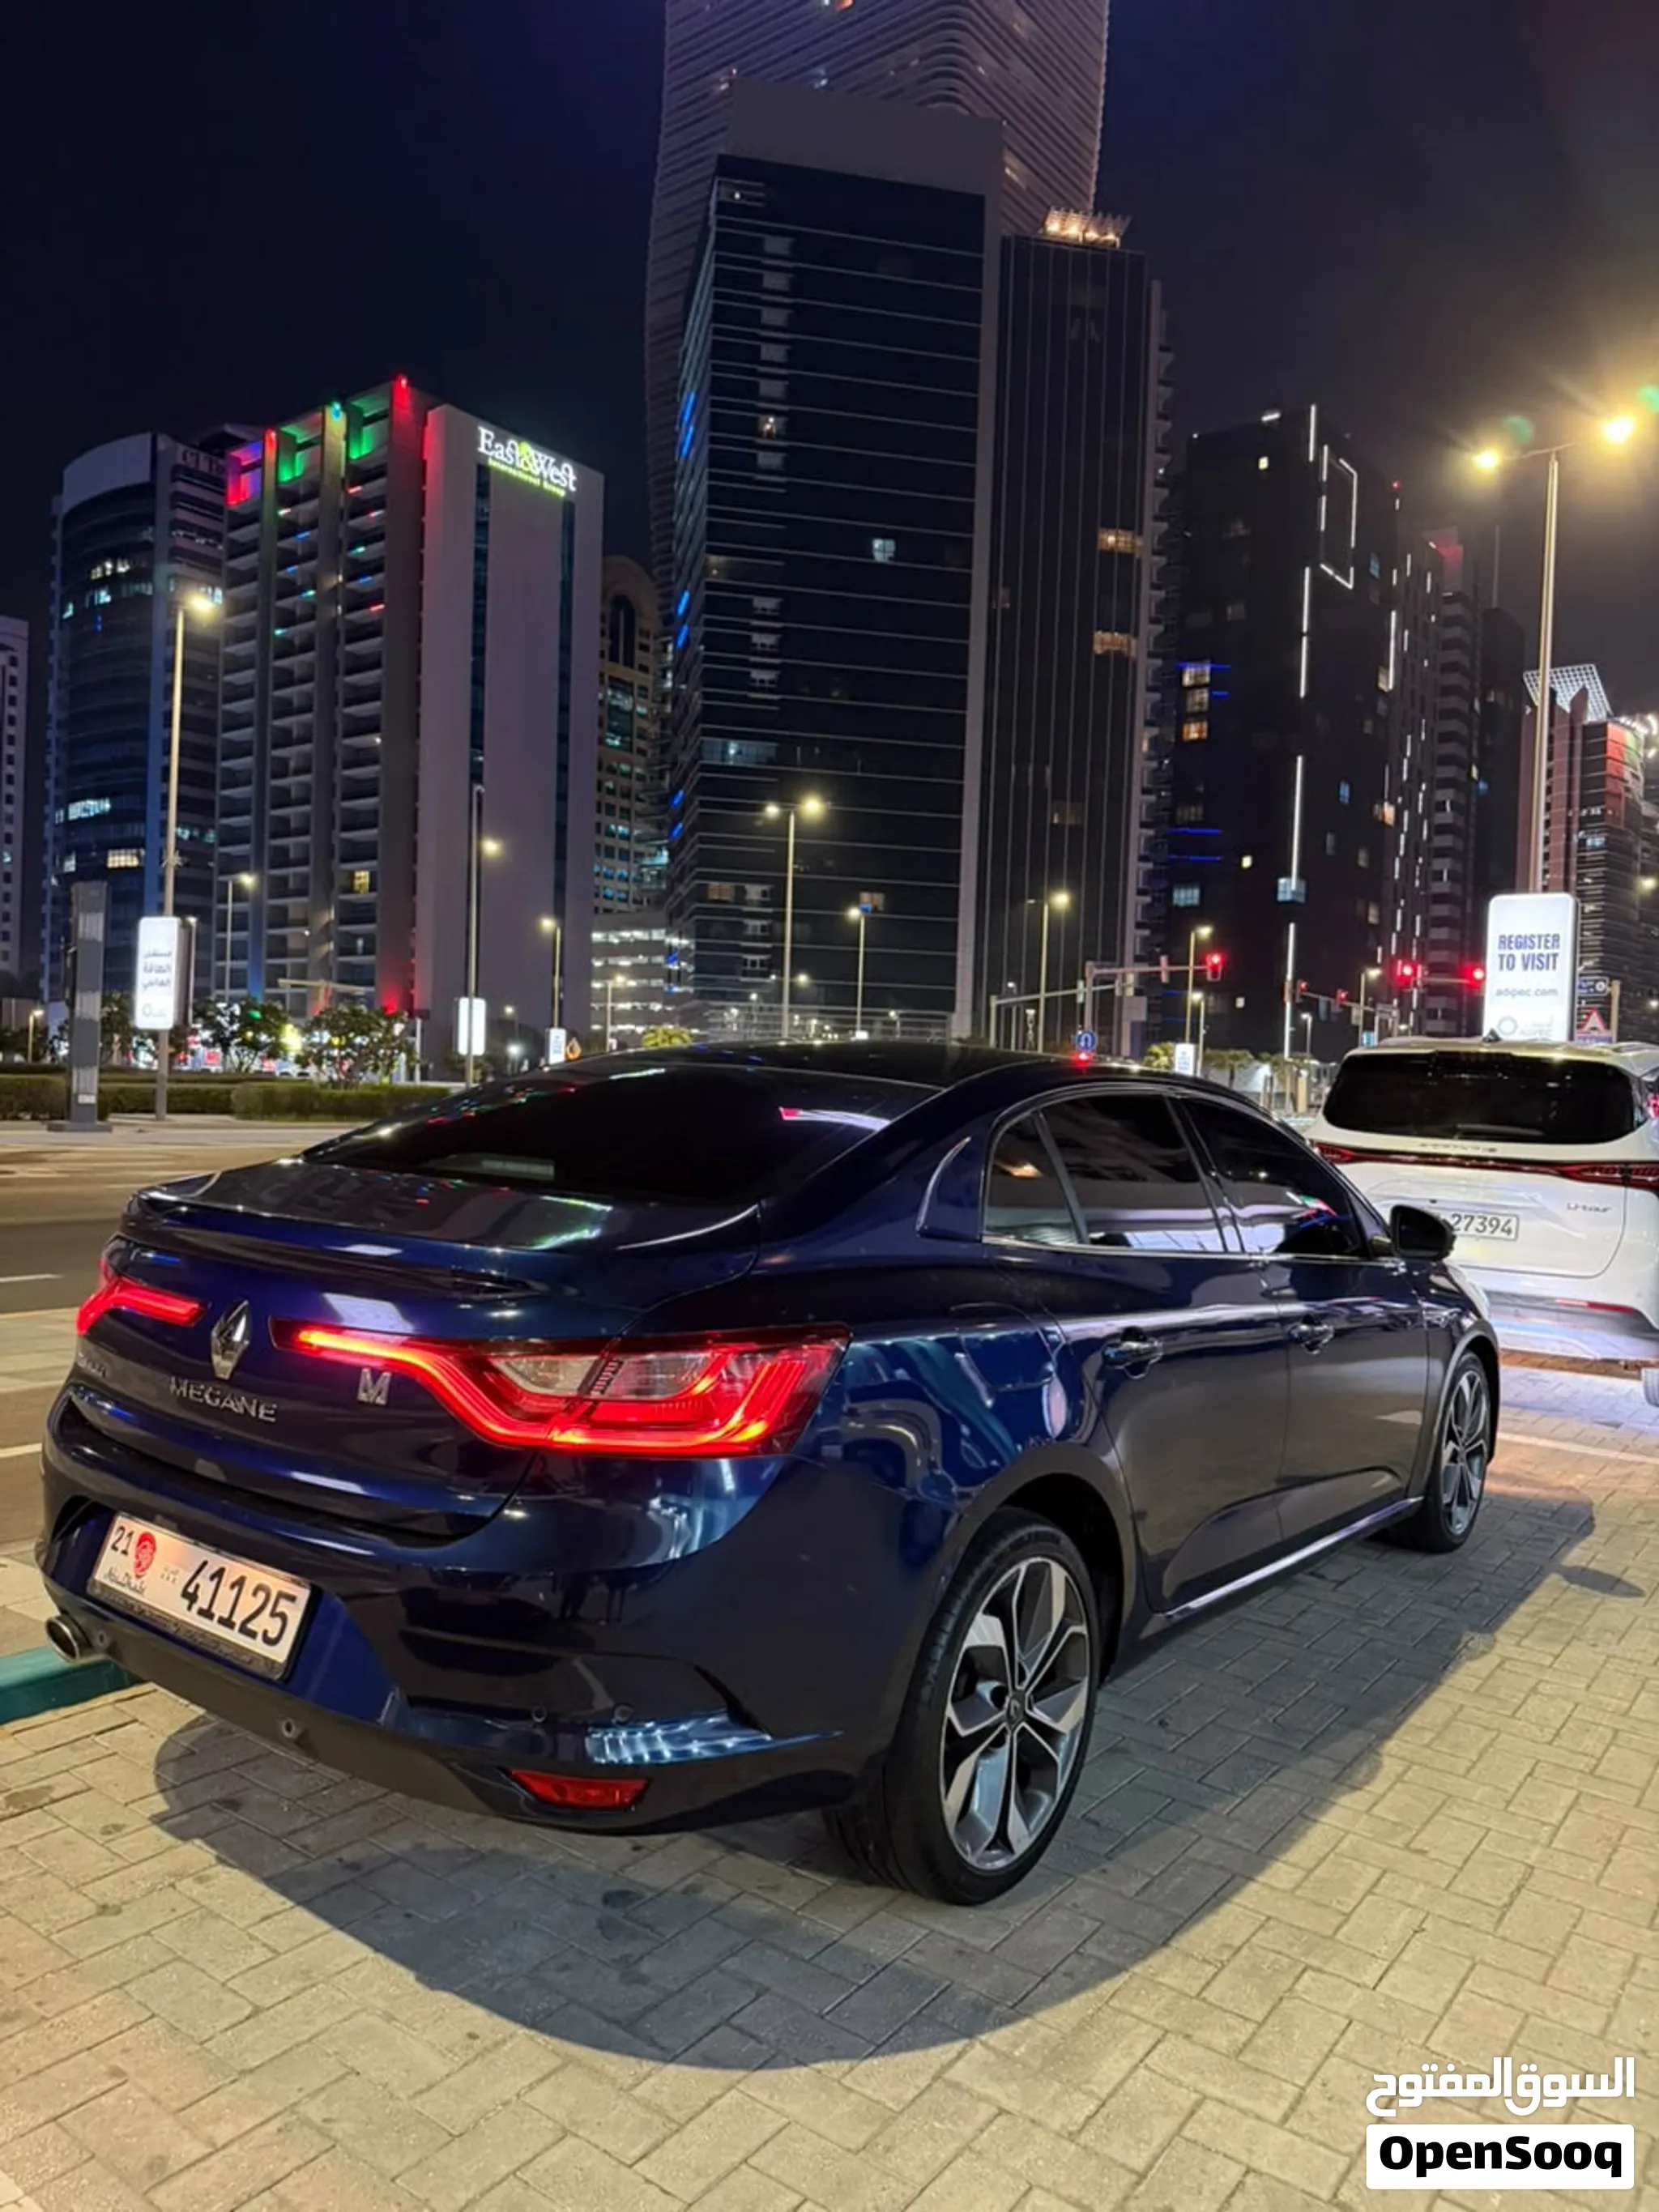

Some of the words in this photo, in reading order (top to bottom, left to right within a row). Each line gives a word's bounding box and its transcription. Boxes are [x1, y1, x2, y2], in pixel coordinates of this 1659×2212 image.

[1498, 933, 1560, 950] REGISTER
[1498, 953, 1516, 971] TO
[1521, 953, 1559, 971] VISIT
[1452, 1213, 1513, 1237] 27394
[169, 1375, 278, 1421] MEGANE
[111, 1526, 134, 1557] 21
[180, 1559, 297, 1647] 41125
